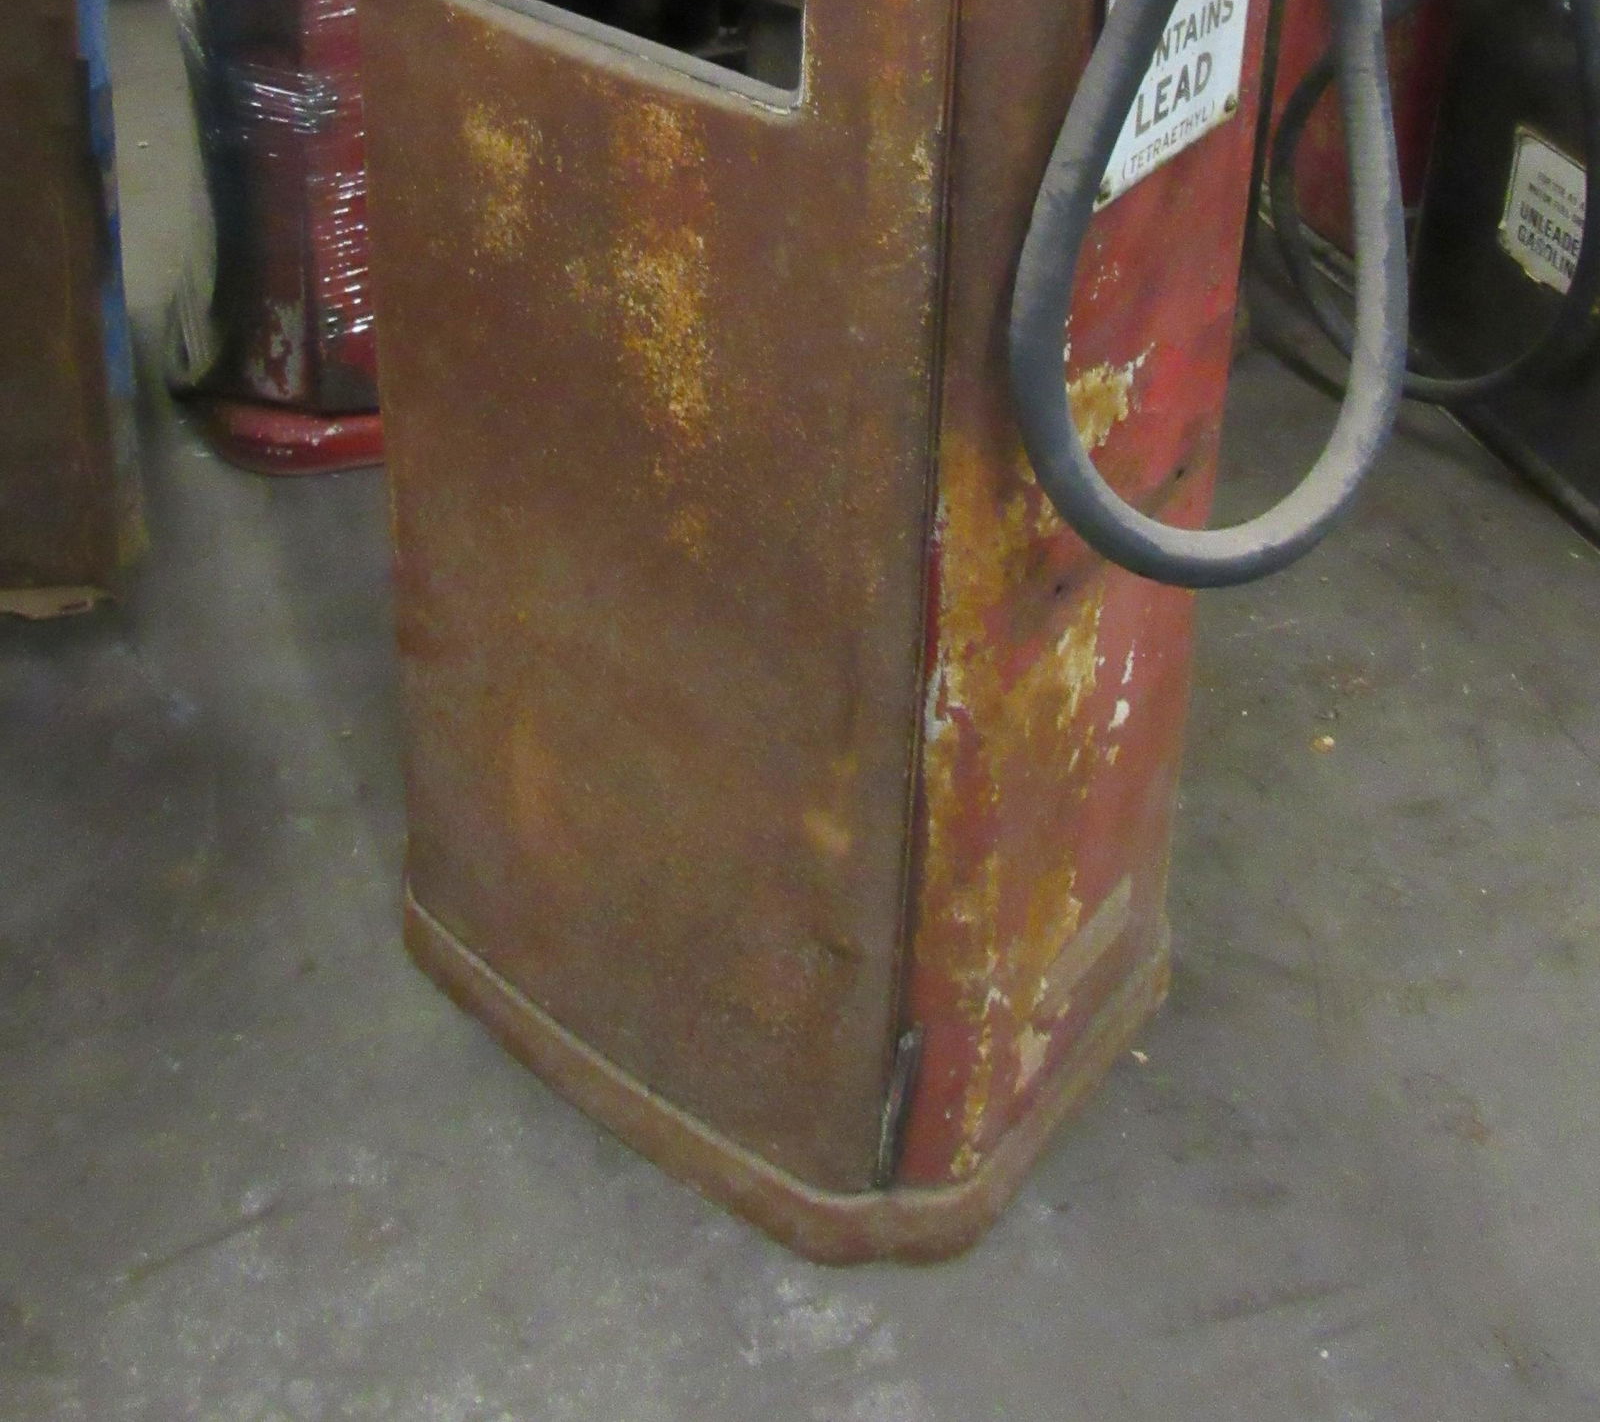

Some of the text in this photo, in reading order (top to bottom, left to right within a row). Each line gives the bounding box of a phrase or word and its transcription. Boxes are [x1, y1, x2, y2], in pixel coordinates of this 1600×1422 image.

[1135, 52, 1213, 139] LEAD
[1122, 99, 1215, 180] (TETRAETHYL)
[1518, 224, 1577, 279] GASOLIN
[1520, 200, 1581, 256] UNLEADE
